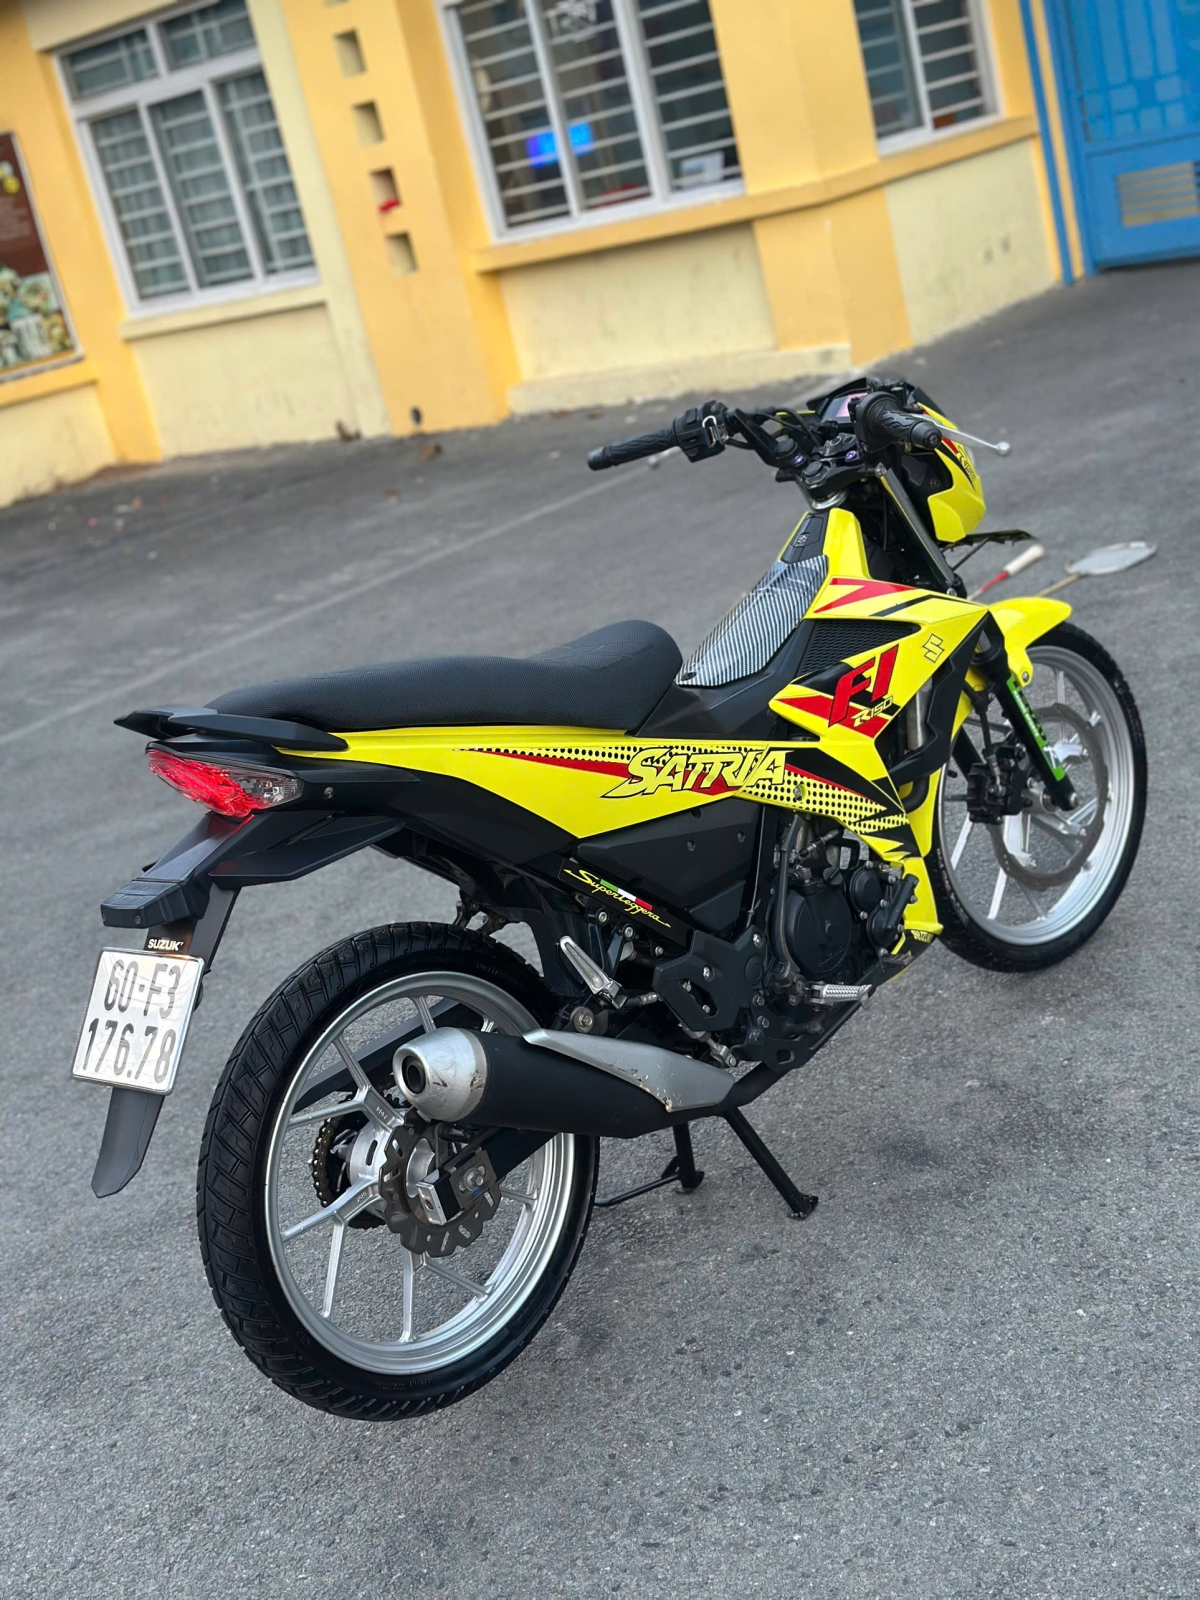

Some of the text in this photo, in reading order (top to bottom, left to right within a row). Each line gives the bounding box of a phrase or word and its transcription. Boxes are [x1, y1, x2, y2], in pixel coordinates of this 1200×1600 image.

[851, 696, 893, 727] R150
[600, 747, 794, 799] SATRIA
[83, 1018, 177, 1083] 176.78
